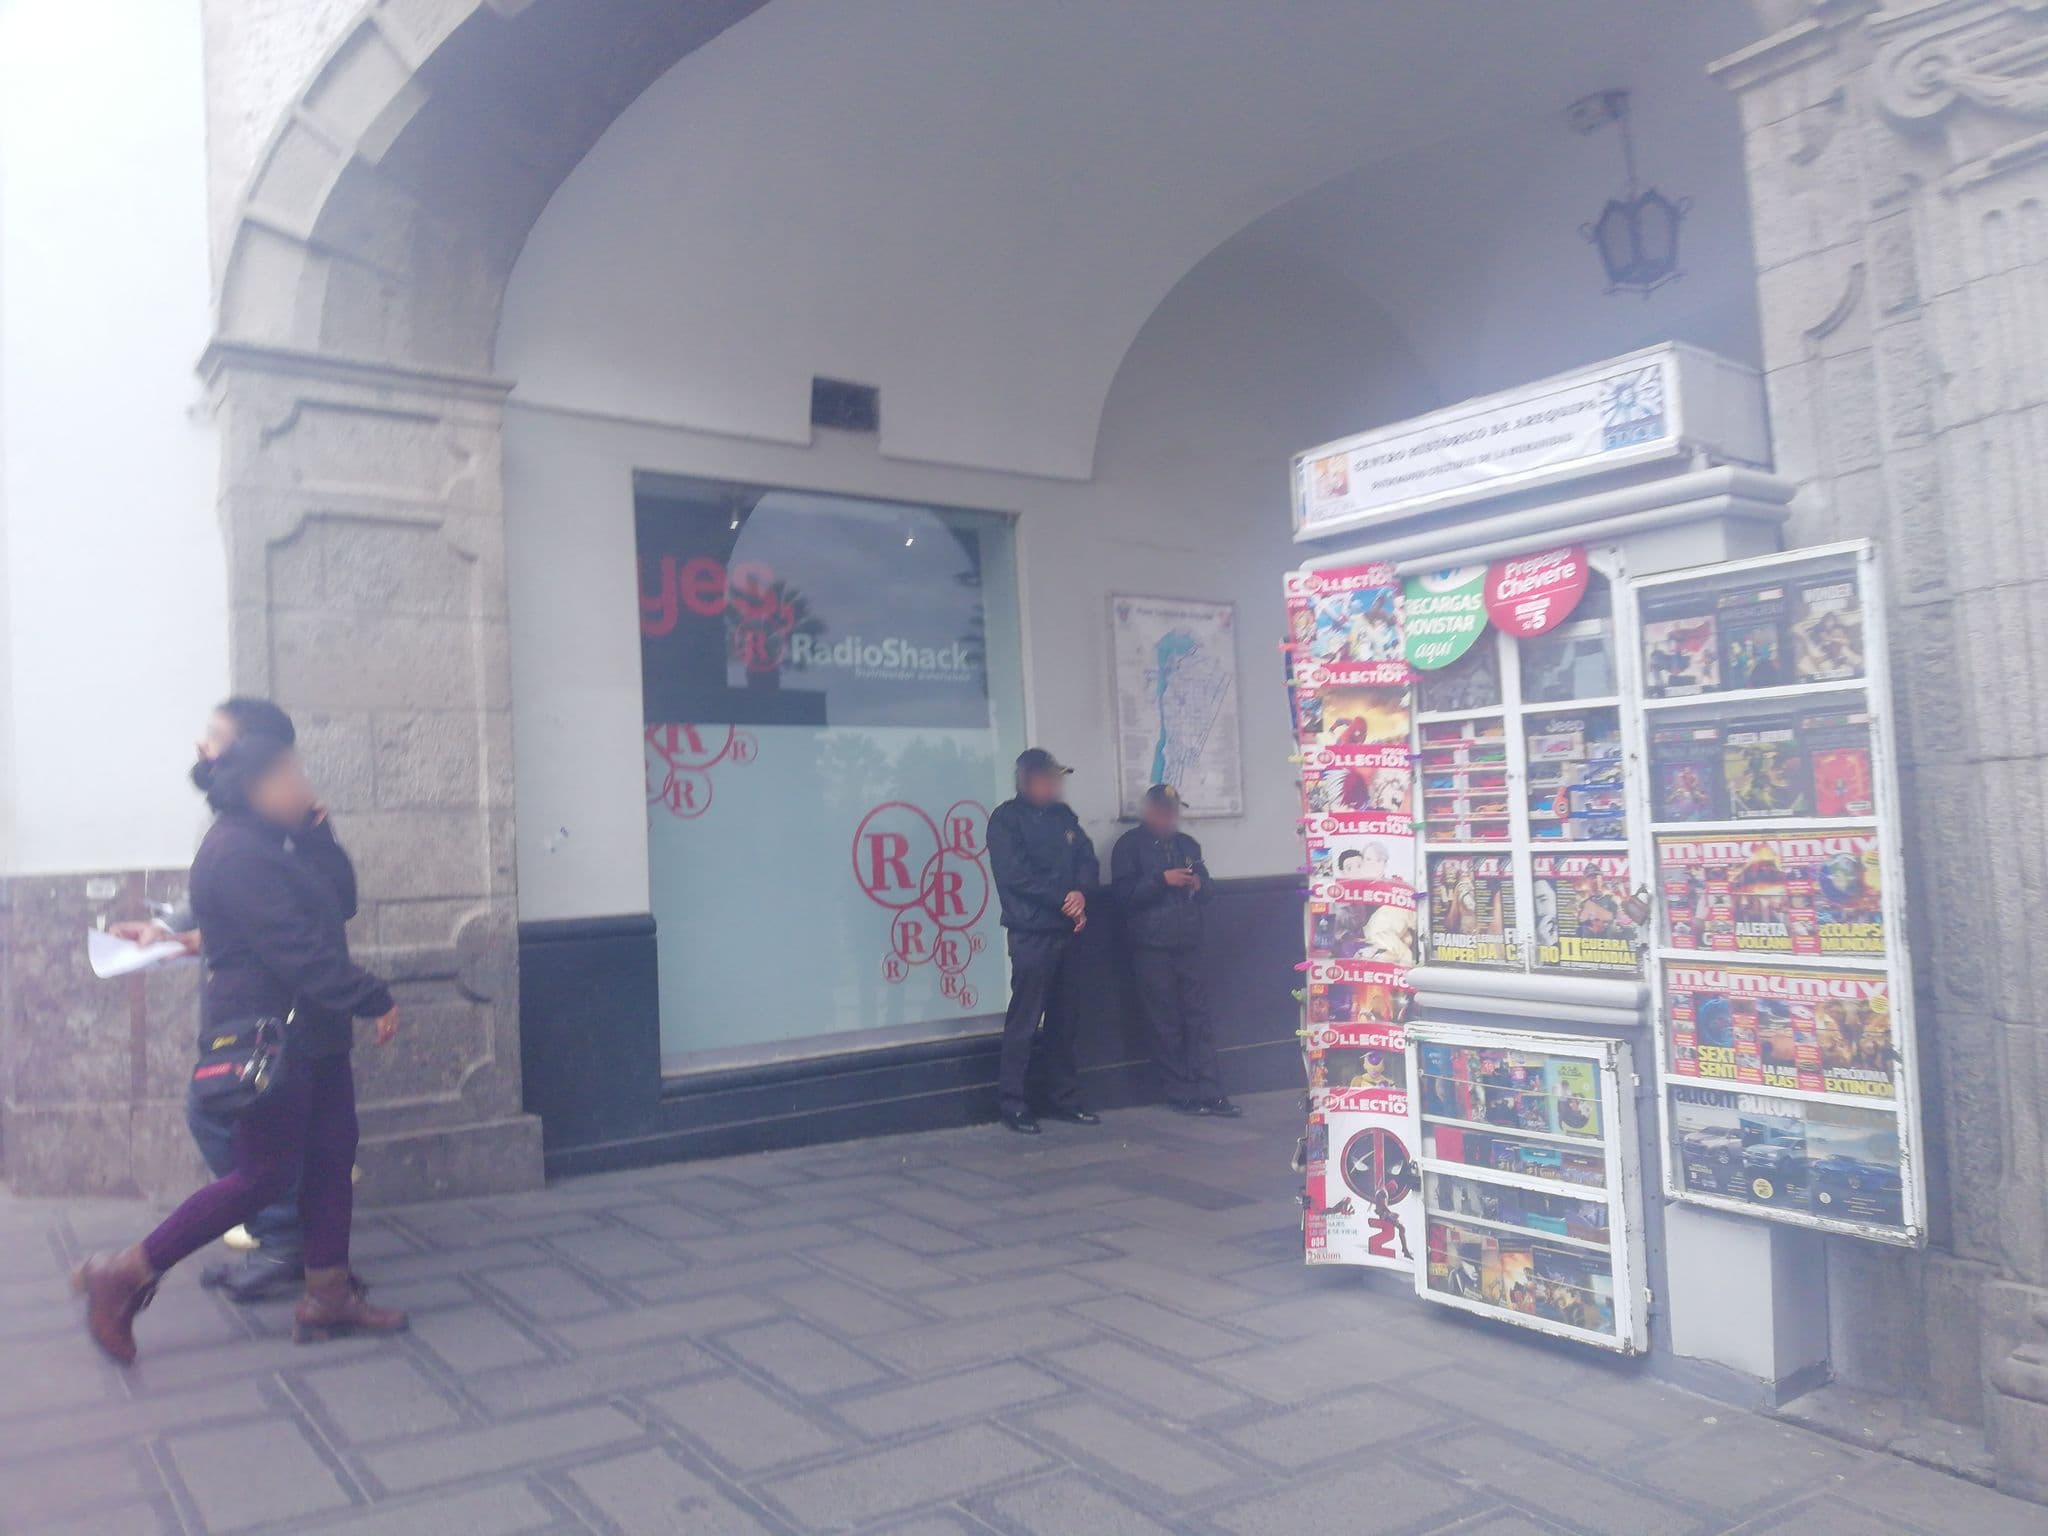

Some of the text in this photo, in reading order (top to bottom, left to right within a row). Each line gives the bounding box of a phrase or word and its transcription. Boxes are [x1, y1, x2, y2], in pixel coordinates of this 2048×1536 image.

[791, 633, 969, 670] RadioShack
[1415, 635, 1457, 664] aquí
[1308, 817, 1413, 836] COLLECTION
[1311, 883, 1417, 909] COLLECTION
[1310, 965, 1416, 989] COLLECTIO
[1310, 1029, 1406, 1050] COLLECTIO
[1697, 1046, 1736, 1064] SEXT
[1311, 1094, 1408, 1115] COLLECTIO
